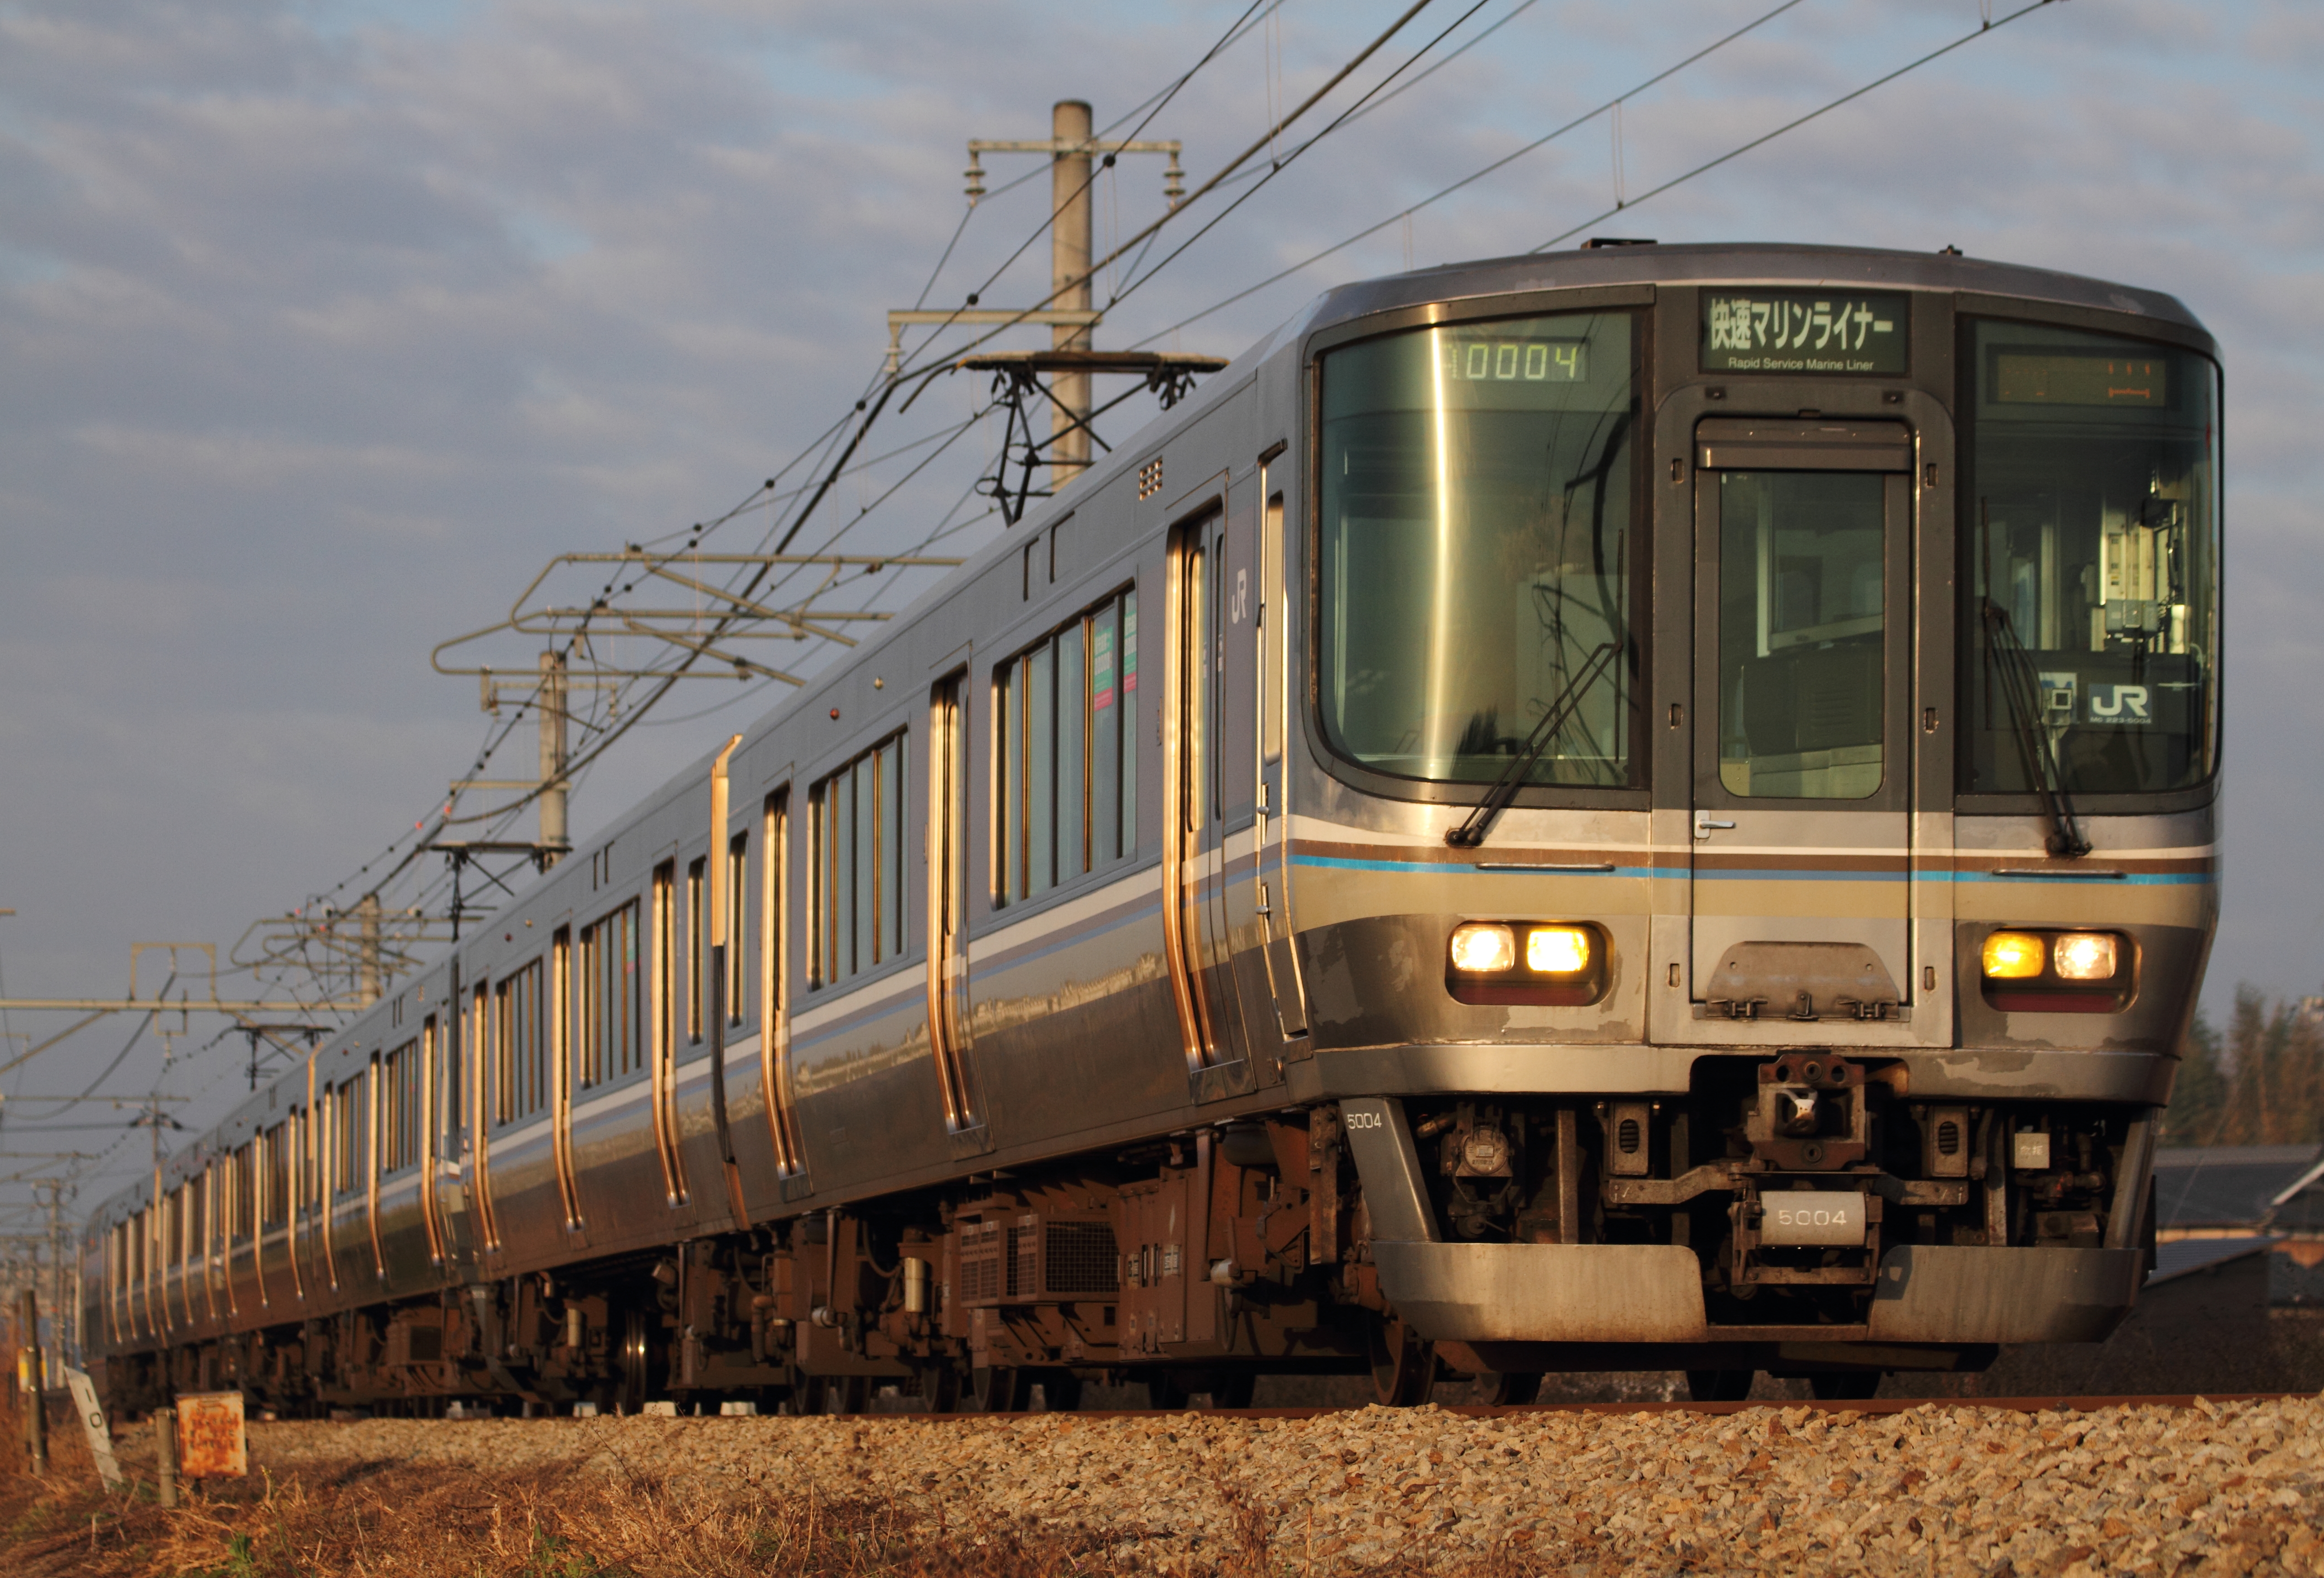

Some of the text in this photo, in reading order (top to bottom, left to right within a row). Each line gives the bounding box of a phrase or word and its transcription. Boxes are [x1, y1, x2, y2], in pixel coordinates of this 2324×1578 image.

[1711, 298, 1893, 350] 快速マリンライナー
[1729, 357, 1874, 370] Rapid Service Marine Liner
[1232, 567, 1247, 624] JR
[2092, 685, 2148, 716] JR
[1347, 1113, 1382, 1129] 5004
[1778, 1210, 1847, 1226] 5004
